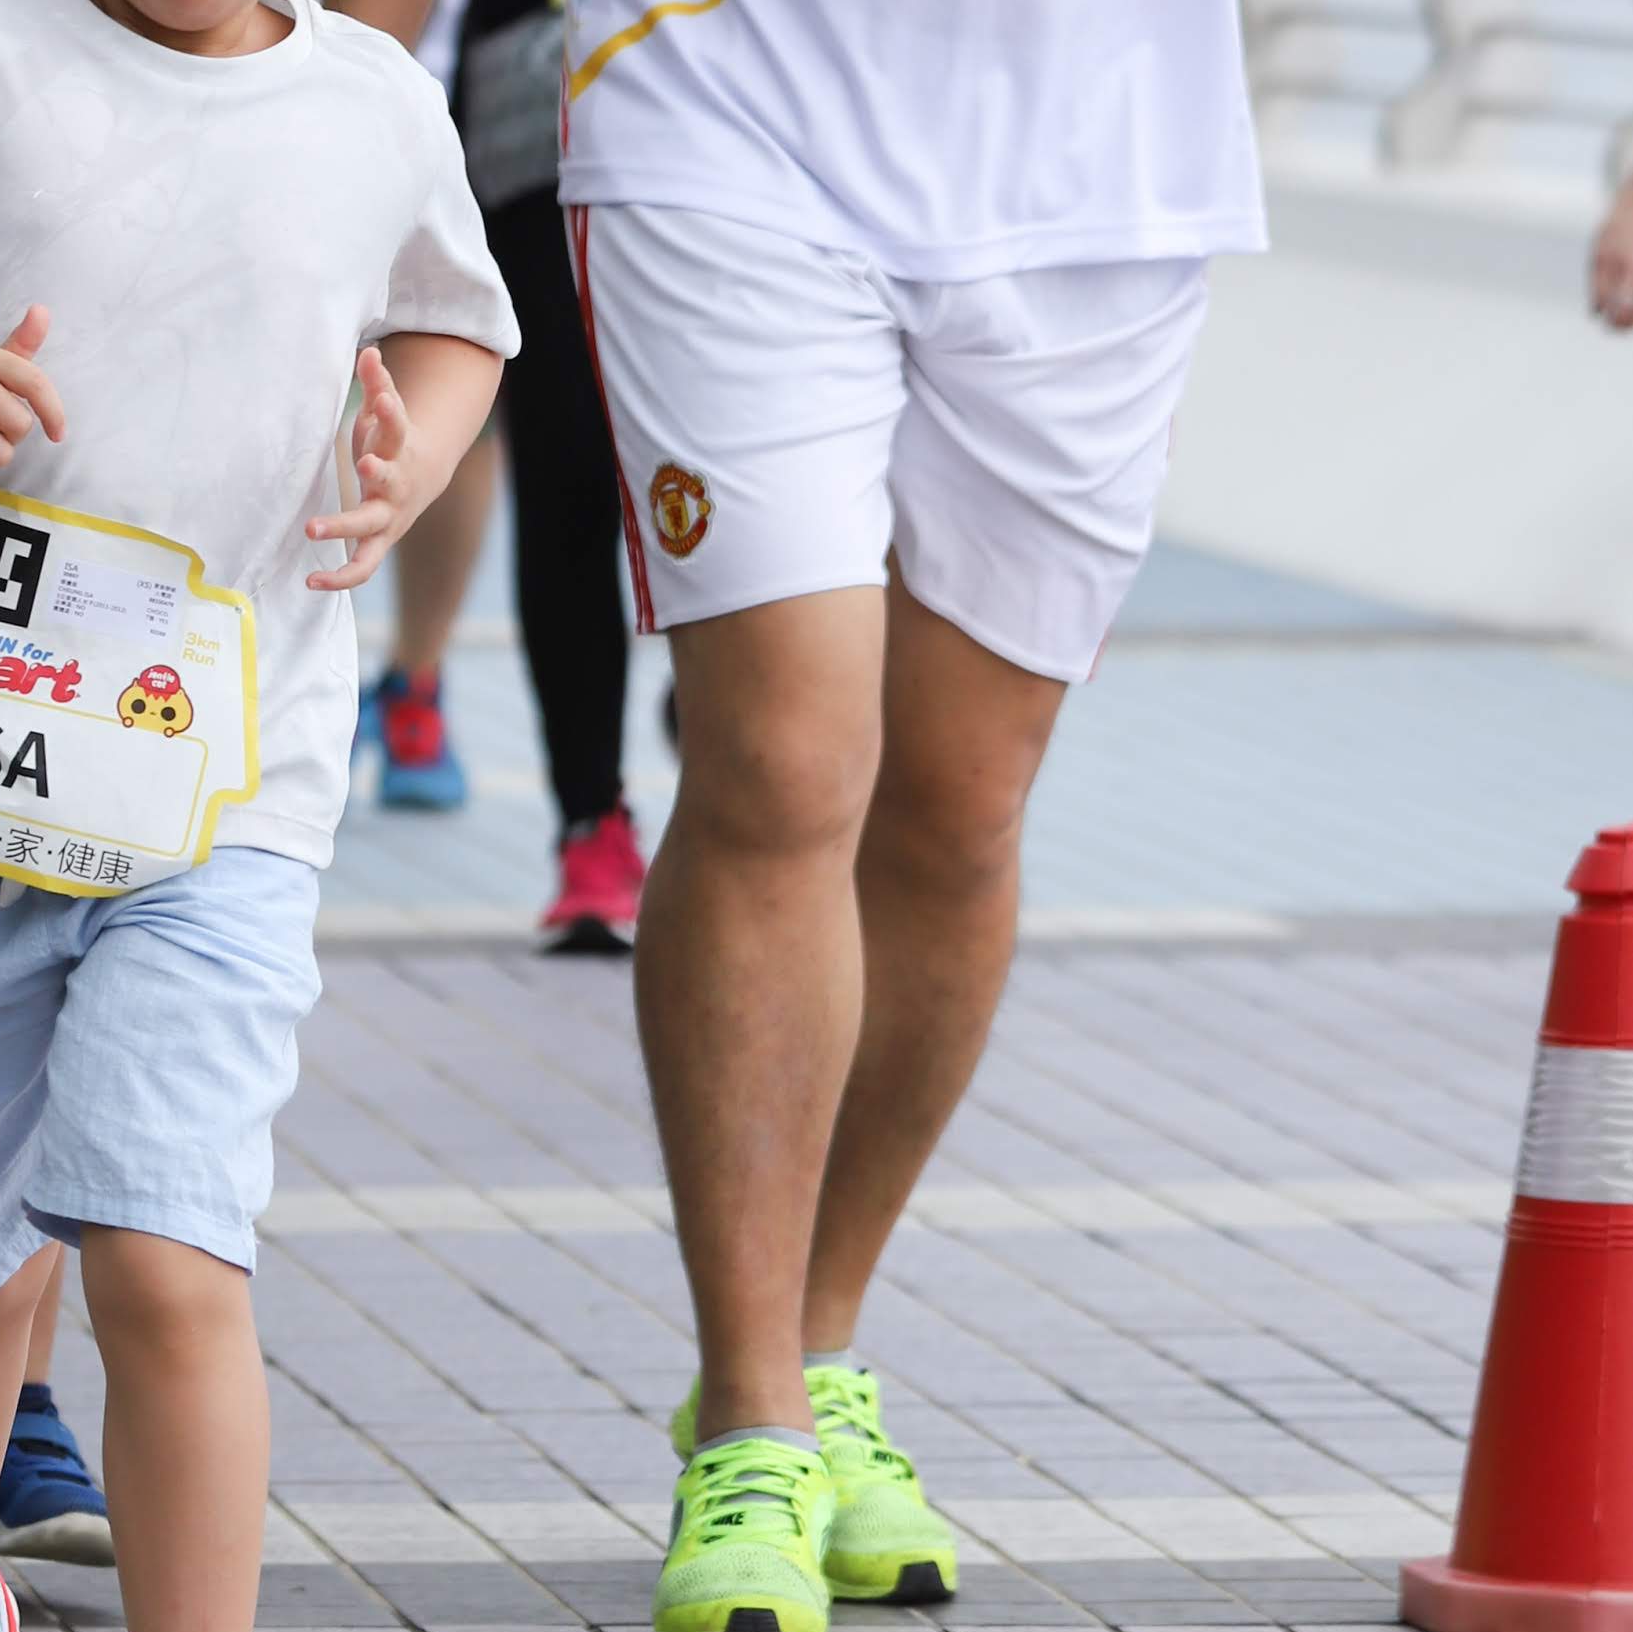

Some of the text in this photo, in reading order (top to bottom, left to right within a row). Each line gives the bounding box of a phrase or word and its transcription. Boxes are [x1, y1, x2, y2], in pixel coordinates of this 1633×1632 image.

[21, 642, 54, 663] for
[184, 631, 221, 653] 3km
[182, 646, 216, 667] Run
